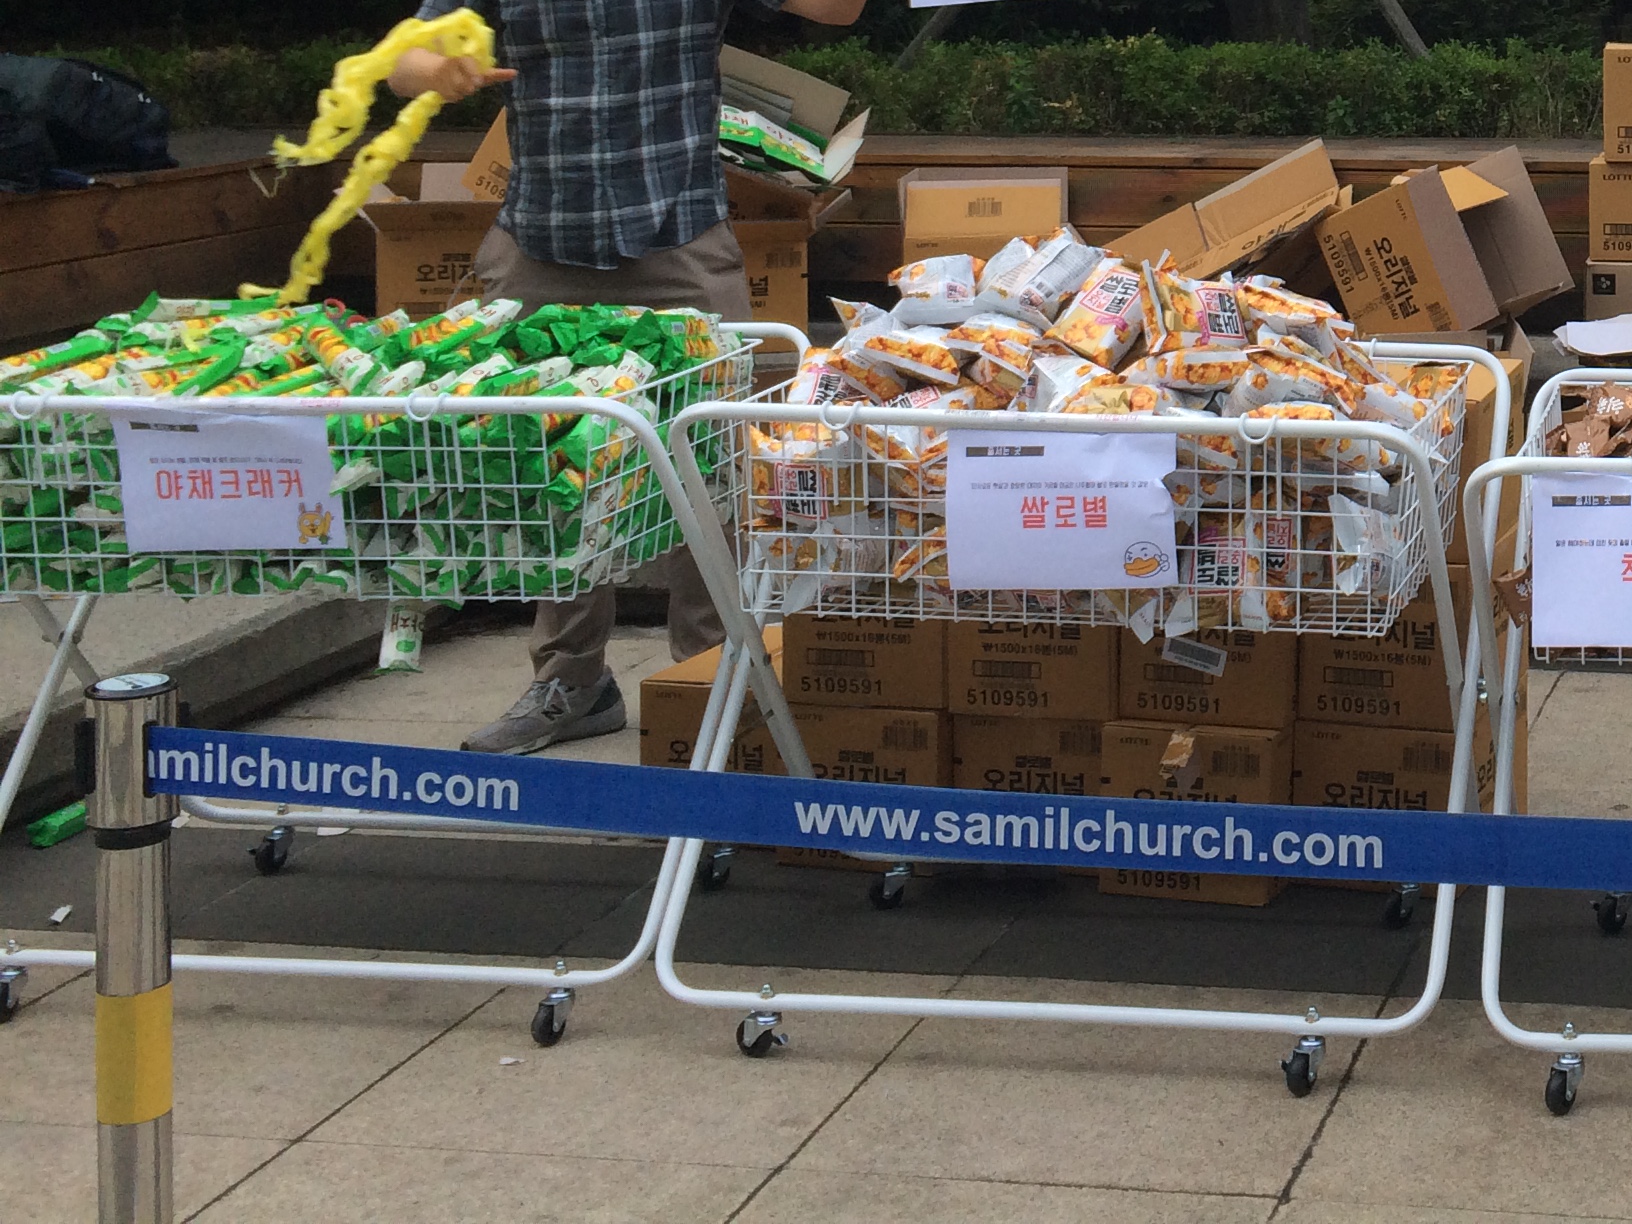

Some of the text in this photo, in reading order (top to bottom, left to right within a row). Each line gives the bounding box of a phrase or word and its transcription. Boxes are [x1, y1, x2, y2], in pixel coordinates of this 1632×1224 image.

[475, 176, 506, 199] 5109
[1322, 234, 1354, 294] 5109591
[1373, 236, 1420, 320] 오리지널
[155, 468, 304, 500] 야채크래커
[1020, 495, 1108, 529] 쌀로별
[800, 677, 883, 696] 5109591
[966, 688, 1049, 708] 5109591
[1137, 692, 1220, 714] 5109591
[1317, 694, 1401, 716] 5109591
[149, 742, 519, 812] milchurch.com
[794, 801, 1384, 869] www.samilchurch.com
